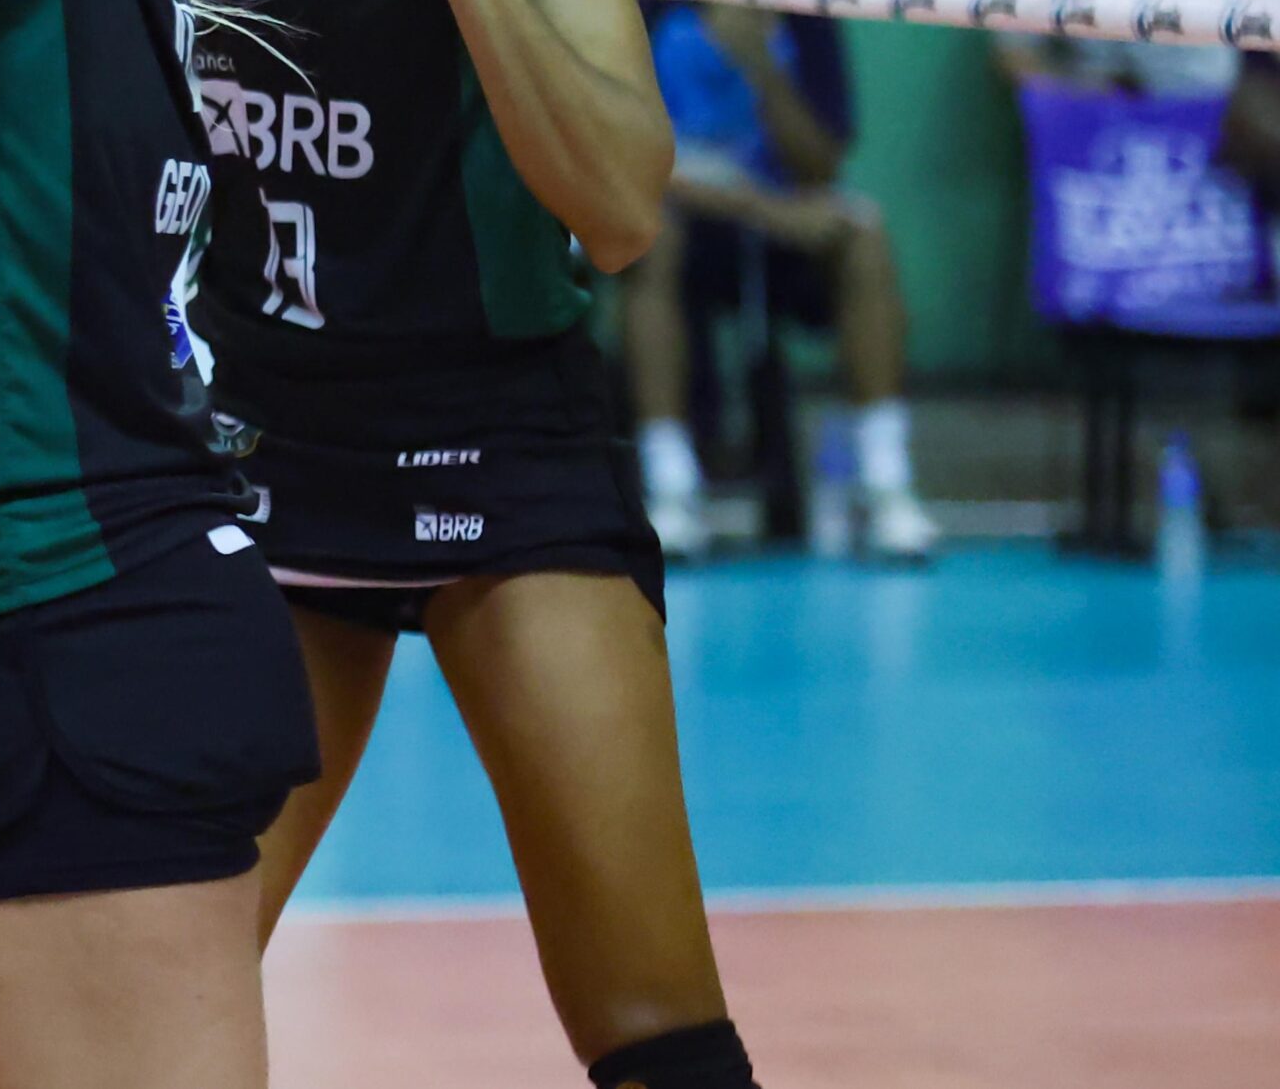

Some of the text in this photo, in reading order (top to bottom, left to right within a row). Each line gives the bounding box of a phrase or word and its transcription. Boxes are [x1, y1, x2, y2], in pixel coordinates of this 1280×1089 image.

[241, 89, 375, 179] BRB
[396, 448, 482, 468] LIDER
[438, 512, 485, 542] BRB
